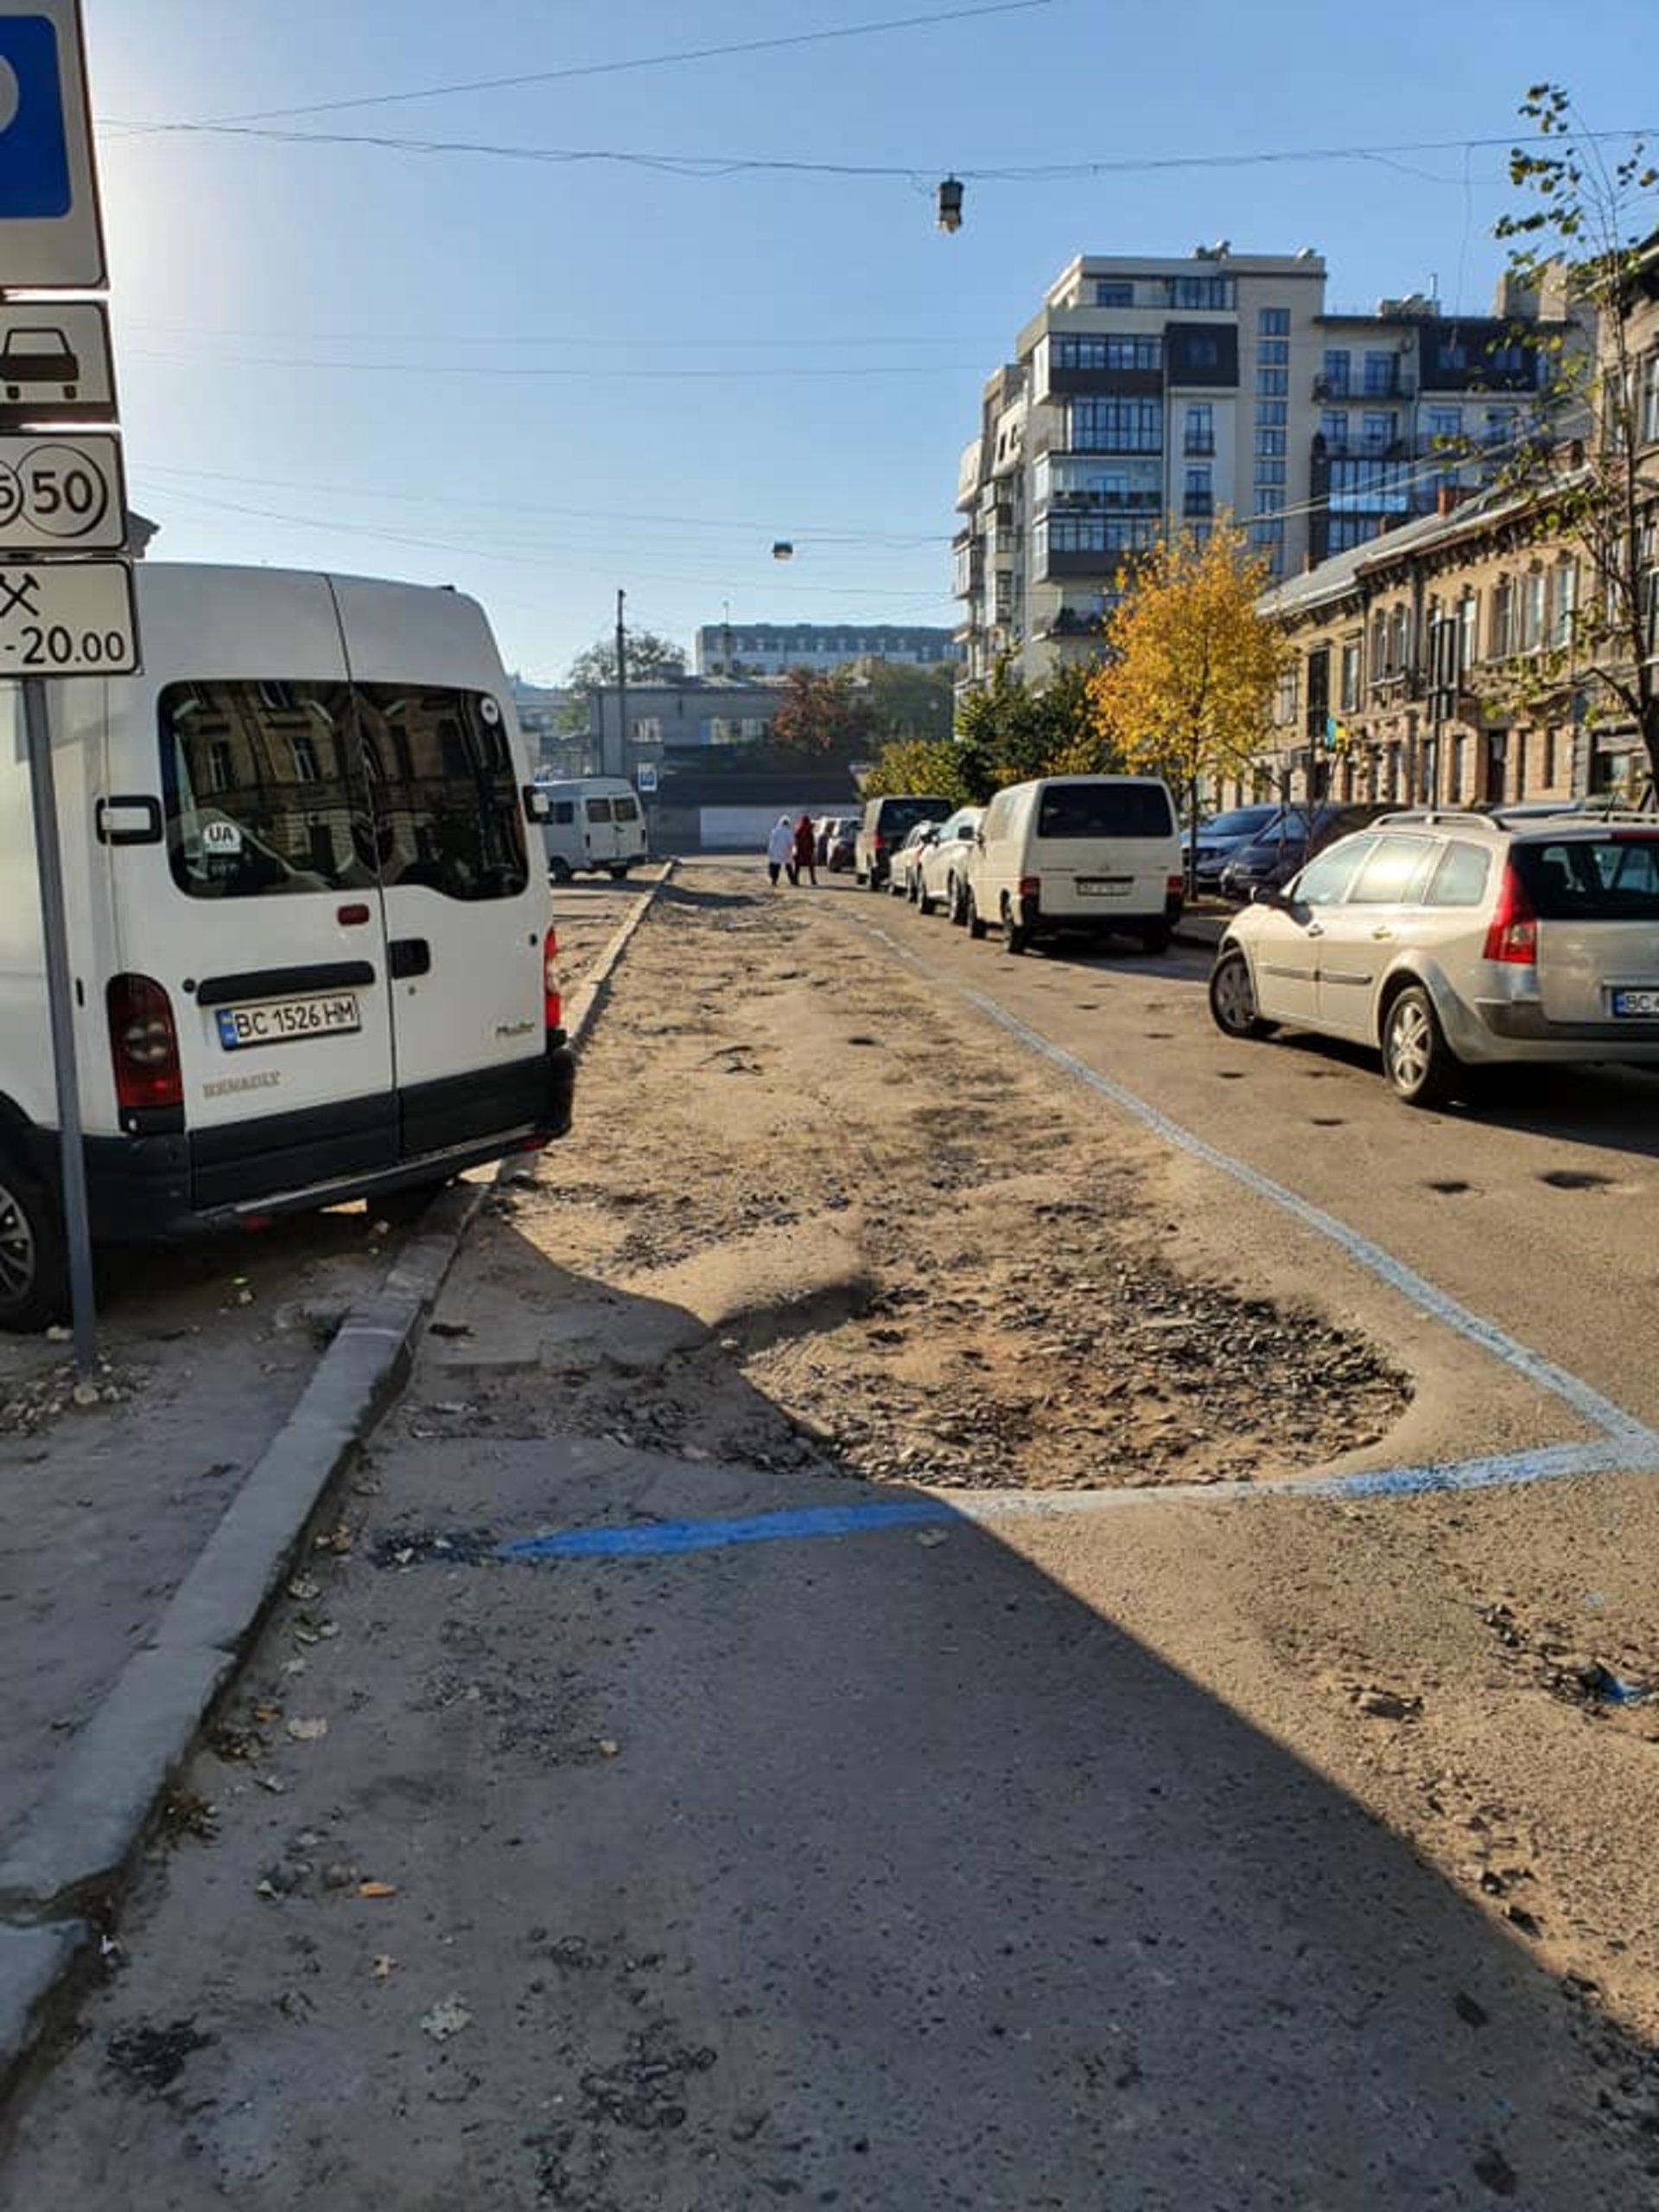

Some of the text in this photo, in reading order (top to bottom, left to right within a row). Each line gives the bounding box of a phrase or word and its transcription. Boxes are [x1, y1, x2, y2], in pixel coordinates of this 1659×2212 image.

[32, 470, 93, 514] 50
[208, 826, 234, 842] UA
[234, 1012, 268, 1037] BC
[272, 1003, 321, 1033] 1526
